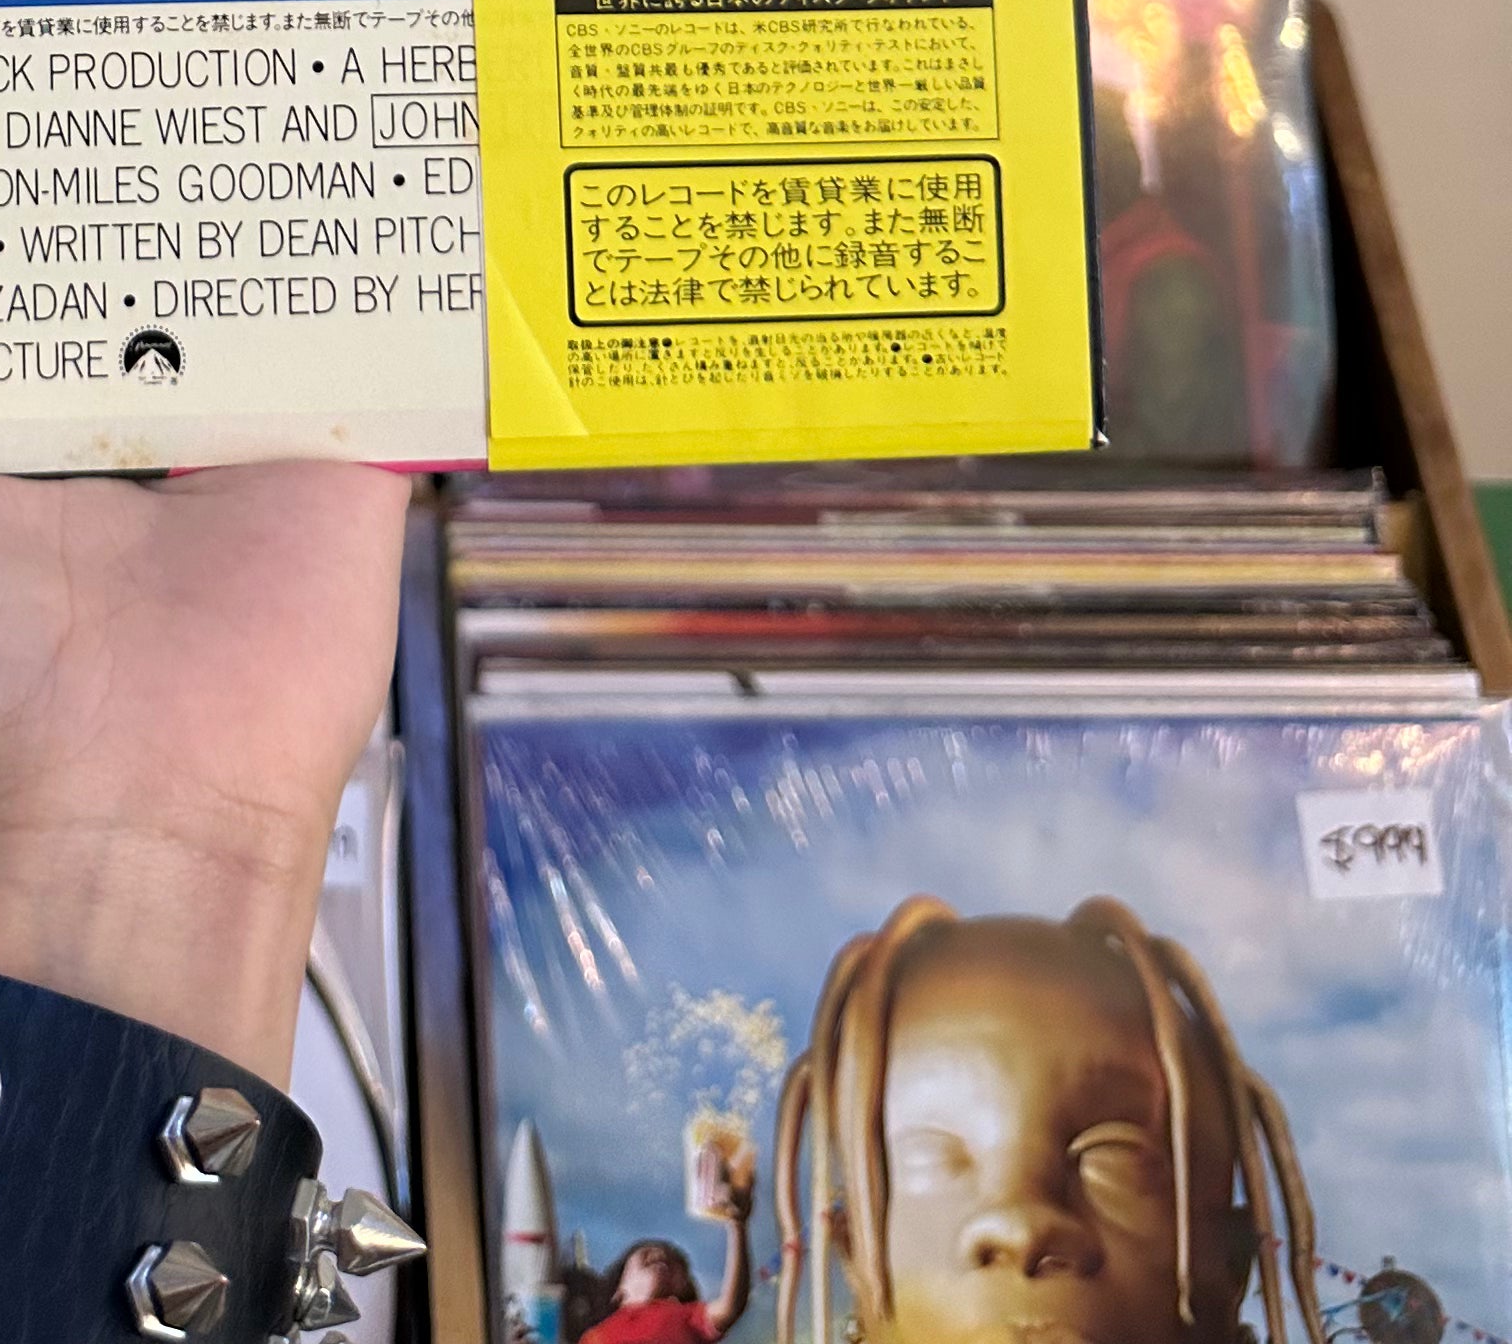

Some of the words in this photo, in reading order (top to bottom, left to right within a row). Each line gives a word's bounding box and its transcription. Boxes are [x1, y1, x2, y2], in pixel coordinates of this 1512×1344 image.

[49, 47, 296, 91] PRODUCTION
[340, 46, 365, 85] A
[6, 108, 143, 149] DIANNE
[155, 105, 268, 145] WIEST
[281, 103, 358, 143] AND
[379, 100, 480, 141] JOHN
[580, 172, 982, 208] このレコードを賃貸業に使用
